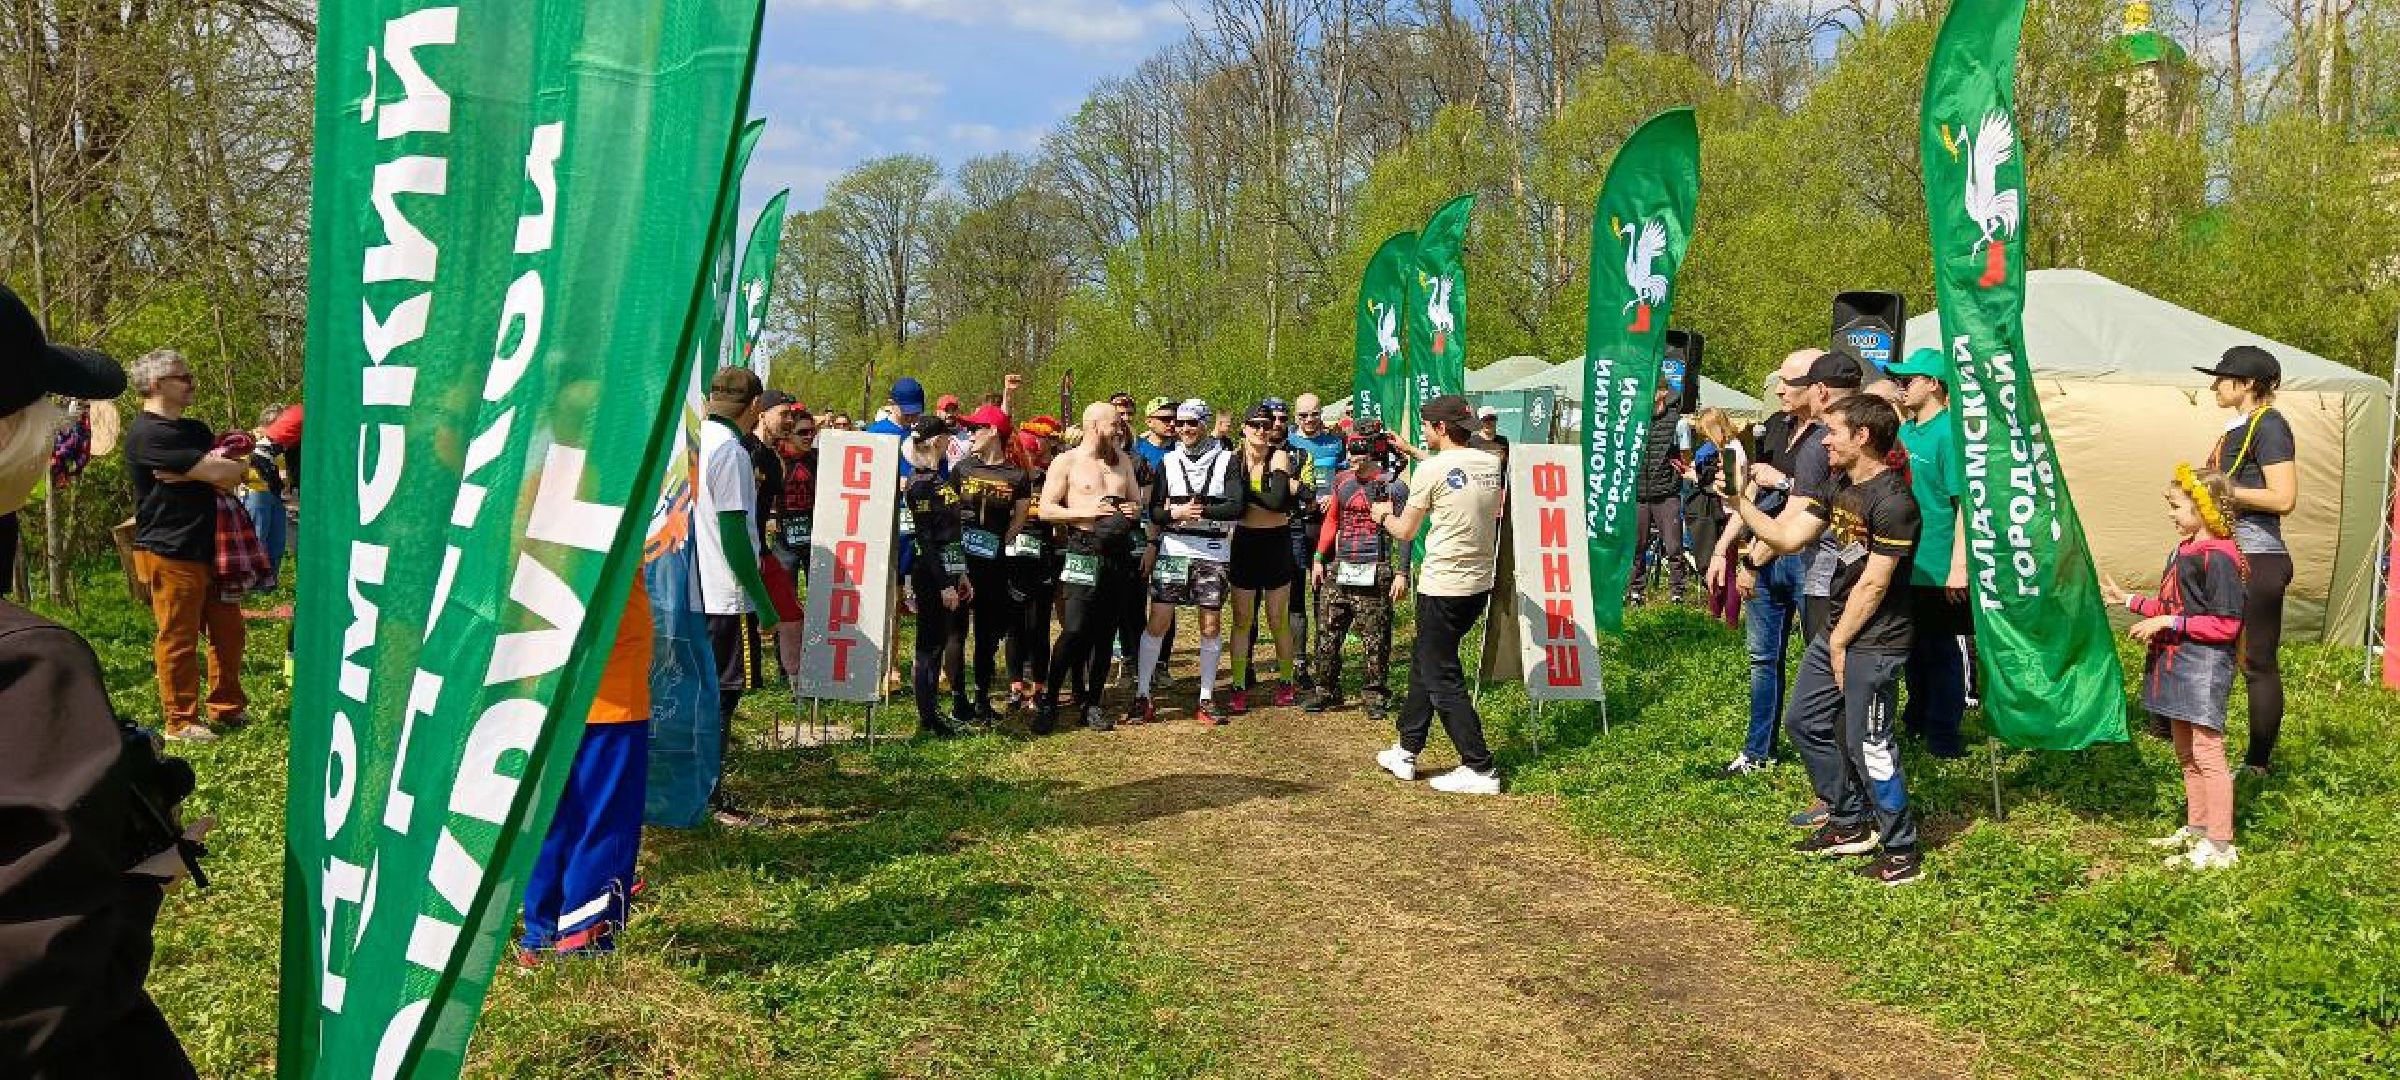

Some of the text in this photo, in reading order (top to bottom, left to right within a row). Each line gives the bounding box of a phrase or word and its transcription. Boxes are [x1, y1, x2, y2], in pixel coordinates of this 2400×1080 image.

[1587, 358, 1613, 539] ТАЛДОМСКИЙ
[1604, 377, 1639, 534] ГОРОДСКОЙ
[826, 445, 874, 682] СТАРТ
[1532, 461, 1583, 687] ФИНИШ
